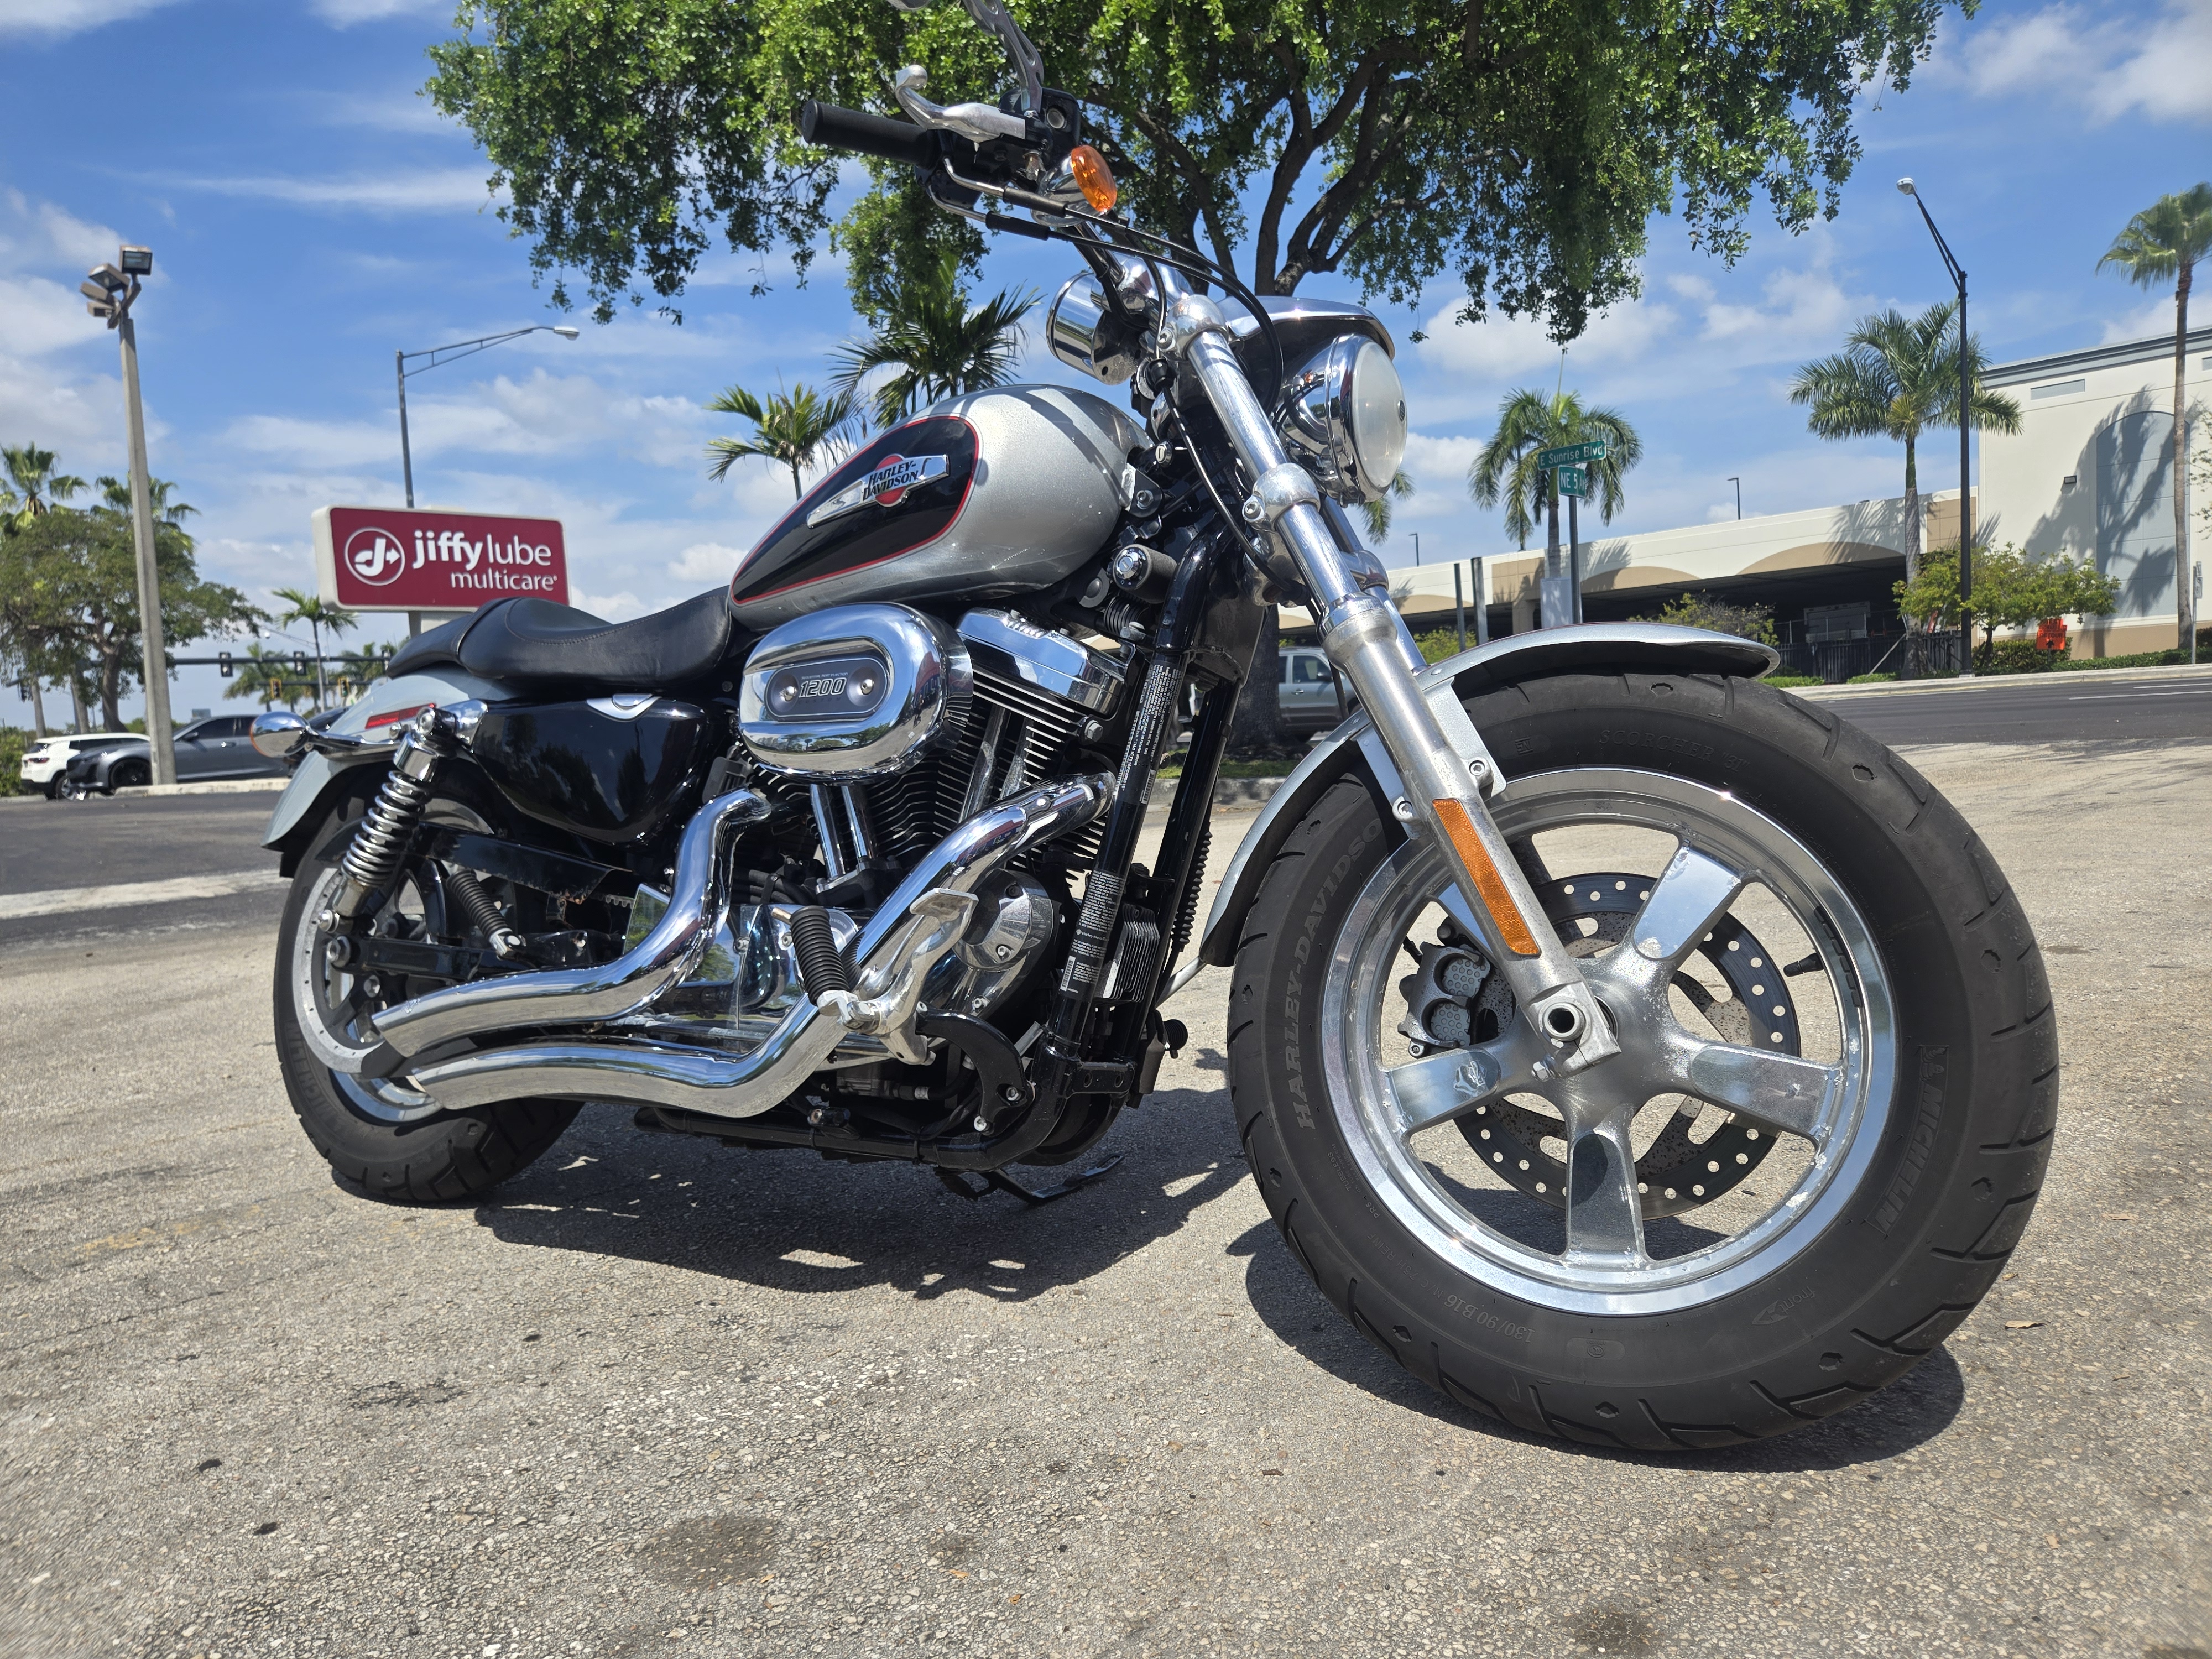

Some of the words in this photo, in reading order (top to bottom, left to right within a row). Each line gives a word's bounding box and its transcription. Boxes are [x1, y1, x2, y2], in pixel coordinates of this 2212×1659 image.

[1540, 455, 1545, 466] E
[1548, 450, 1580, 465] Sunrise
[1584, 445, 1603, 457] Blvd
[863, 471, 919, 501] DAVIDSON
[868, 461, 916, 489] HARLEY-
[1561, 472, 1571, 488] NE
[1573, 474, 1578, 489] 5
[799, 677, 847, 698] 1200
[1599, 729, 1715, 761] SCORCHER
[1722, 752, 1751, 773] "31"
[1843, 872, 1870, 909] trademarks
[1280, 818, 1383, 1130] HARLEY-DAVIDSO
[284, 1019, 336, 1125] MICHELIN
[1337, 1154, 1347, 1169] TYPE
[1874, 1082, 1944, 1232] MICHELIN
[1328, 1152, 1352, 1191] TUBELESS
[1345, 1170, 1355, 1184] TUBE
[1366, 1233, 1397, 1261] REINF
[1396, 1259, 1420, 1281] 73H
[1420, 1279, 1444, 1298] M/C
[1777, 1286, 1816, 1315] front
[1443, 1295, 1479, 1320] B16
[1476, 1311, 1536, 1344] 130/90
